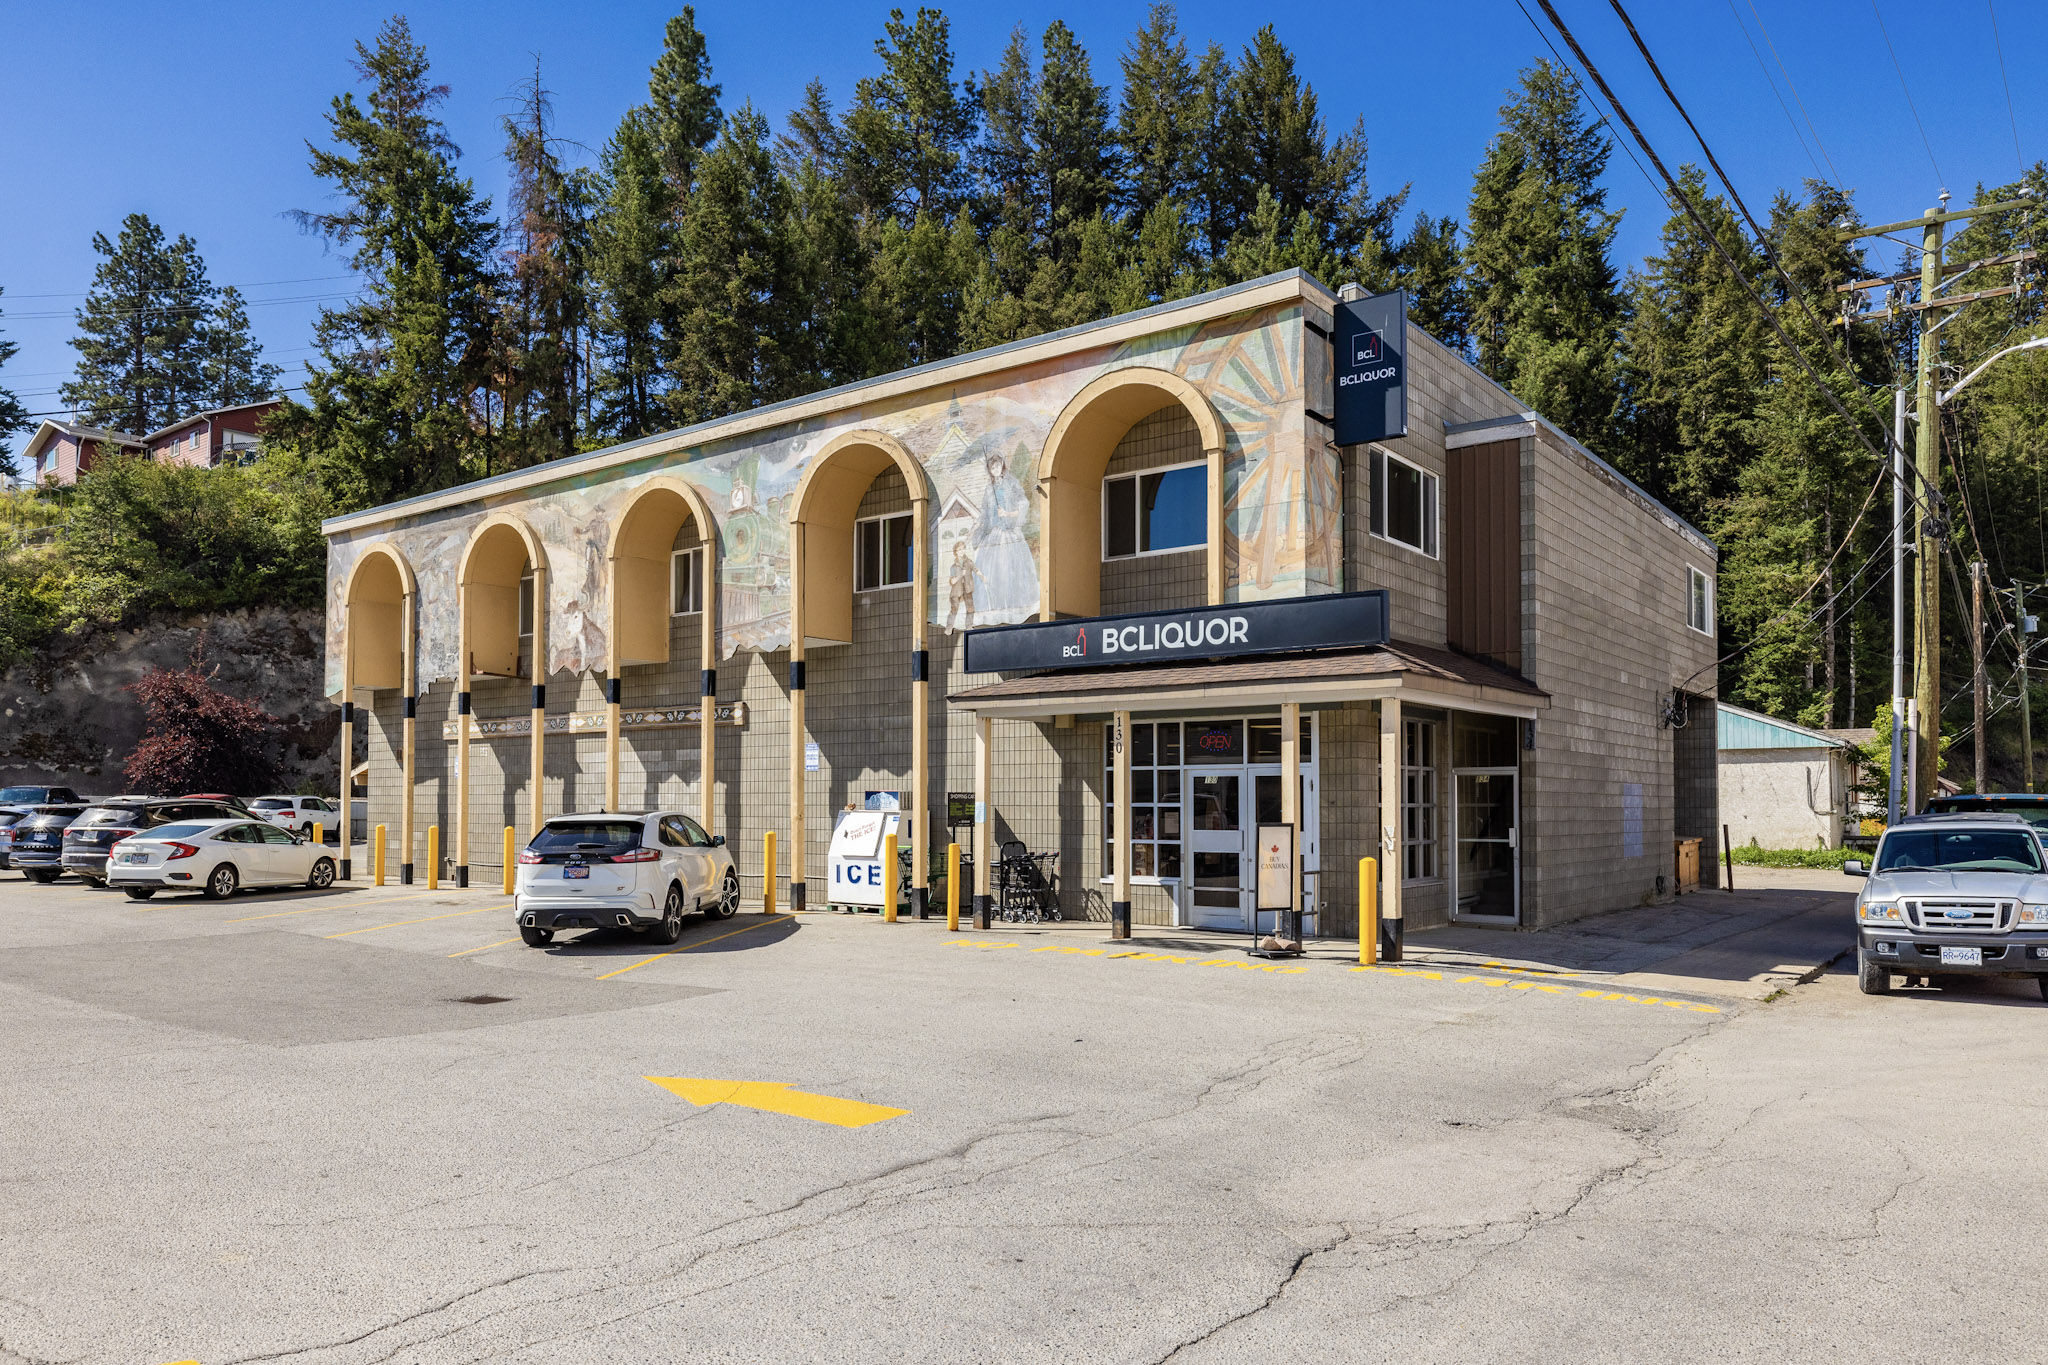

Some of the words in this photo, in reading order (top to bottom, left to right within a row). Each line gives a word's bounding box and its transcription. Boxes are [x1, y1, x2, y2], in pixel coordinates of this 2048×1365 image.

[1340, 367, 1396, 386] BCLIQUOR
[1102, 616, 1248, 654] BCLIQUOR
[1115, 717, 1123, 753] 130
[1200, 735, 1232, 749] OPEN
[836, 864, 881, 886] ICE
